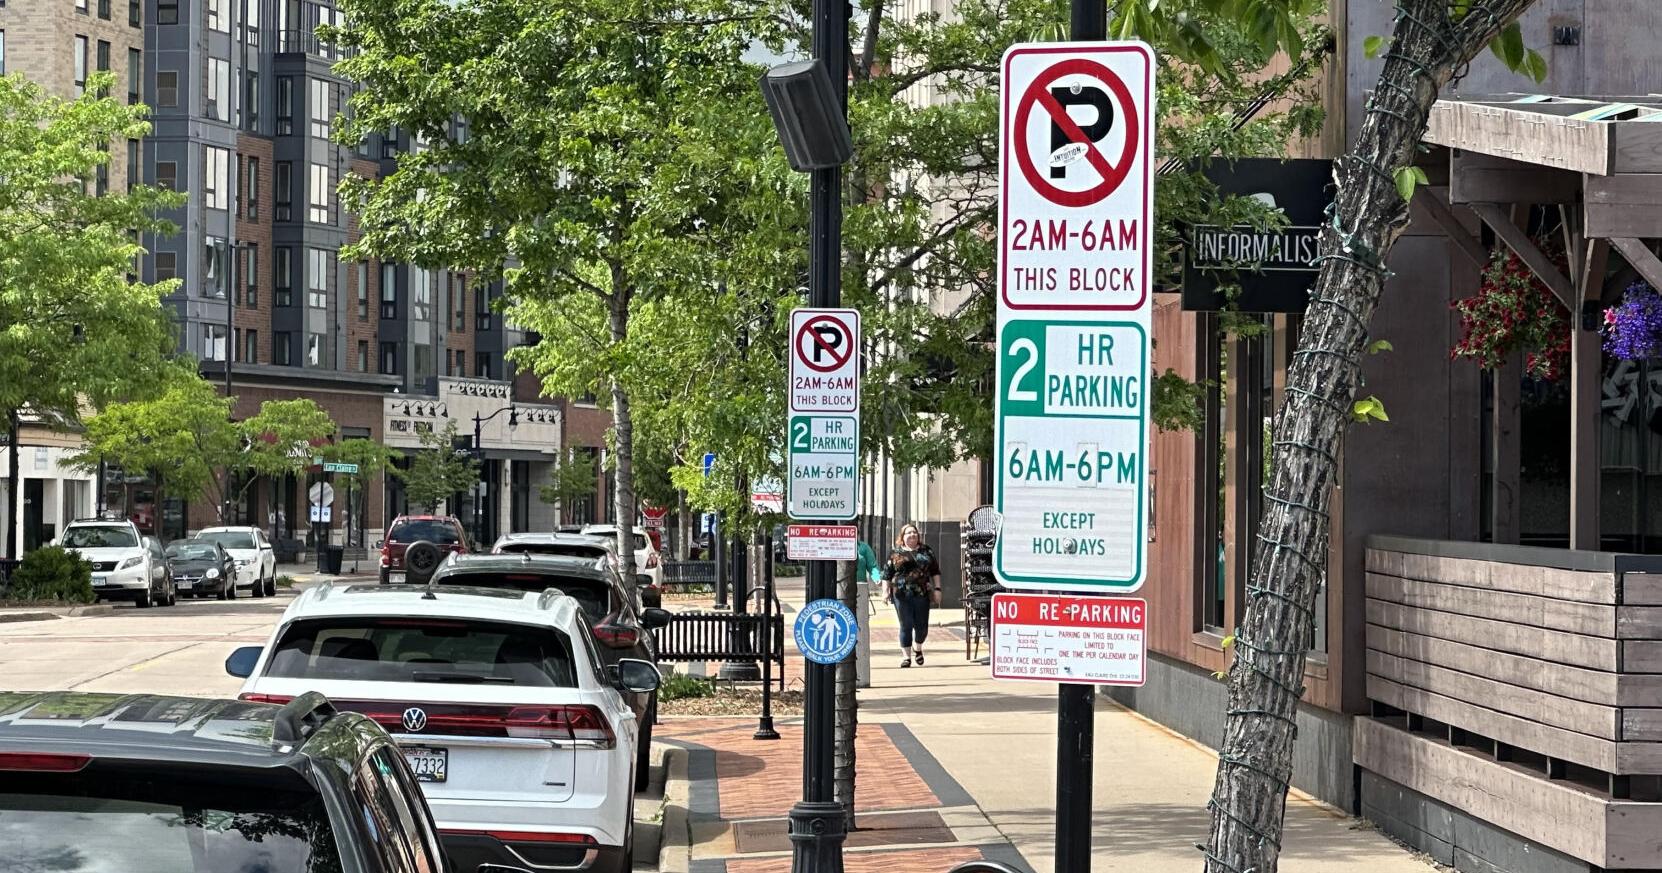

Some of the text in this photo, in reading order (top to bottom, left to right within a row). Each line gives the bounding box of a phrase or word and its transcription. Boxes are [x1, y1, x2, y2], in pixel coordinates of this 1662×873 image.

[1053, 145, 1082, 162] INTUITION
[1012, 219, 1138, 251] 2AM-6AM
[1014, 267, 1135, 292] THIS BLOCK
[1077, 333, 1114, 366] HR
[1007, 337, 1039, 402] 2
[795, 376, 854, 390] 2AM-6AM
[1048, 374, 1138, 409] PARKING
[796, 395, 852, 406] THIS BLOCK
[825, 420, 843, 434] HR
[793, 422, 809, 448] 2
[812, 436, 854, 450] PARKING
[794, 465, 853, 479] 6AM-6PM
[1009, 447, 1136, 484] 6AM-6PM
[809, 487, 840, 497] EXCEPT
[1043, 511, 1096, 530] EXCEPT
[790, 528, 800, 536] NO
[1032, 537, 1106, 556] HOLDAYS
[798, 600, 856, 625] PEDESTRIAN ZONE
[997, 601, 1142, 625] NO RE-PARKING
[1058, 630, 1141, 642] PARKING ON THIS BLOCK FACE
[1084, 641, 1115, 650] LIMITED TO
[806, 651, 823, 663] WALK
[823, 653, 841, 663] YOUR
[996, 656, 1058, 666] BLOCK FACE INCLUDES
[1058, 650, 1140, 661] ONE TIME PER CALENDAR DAY
[996, 665, 1059, 676] BOTH SIDES OF STREET
